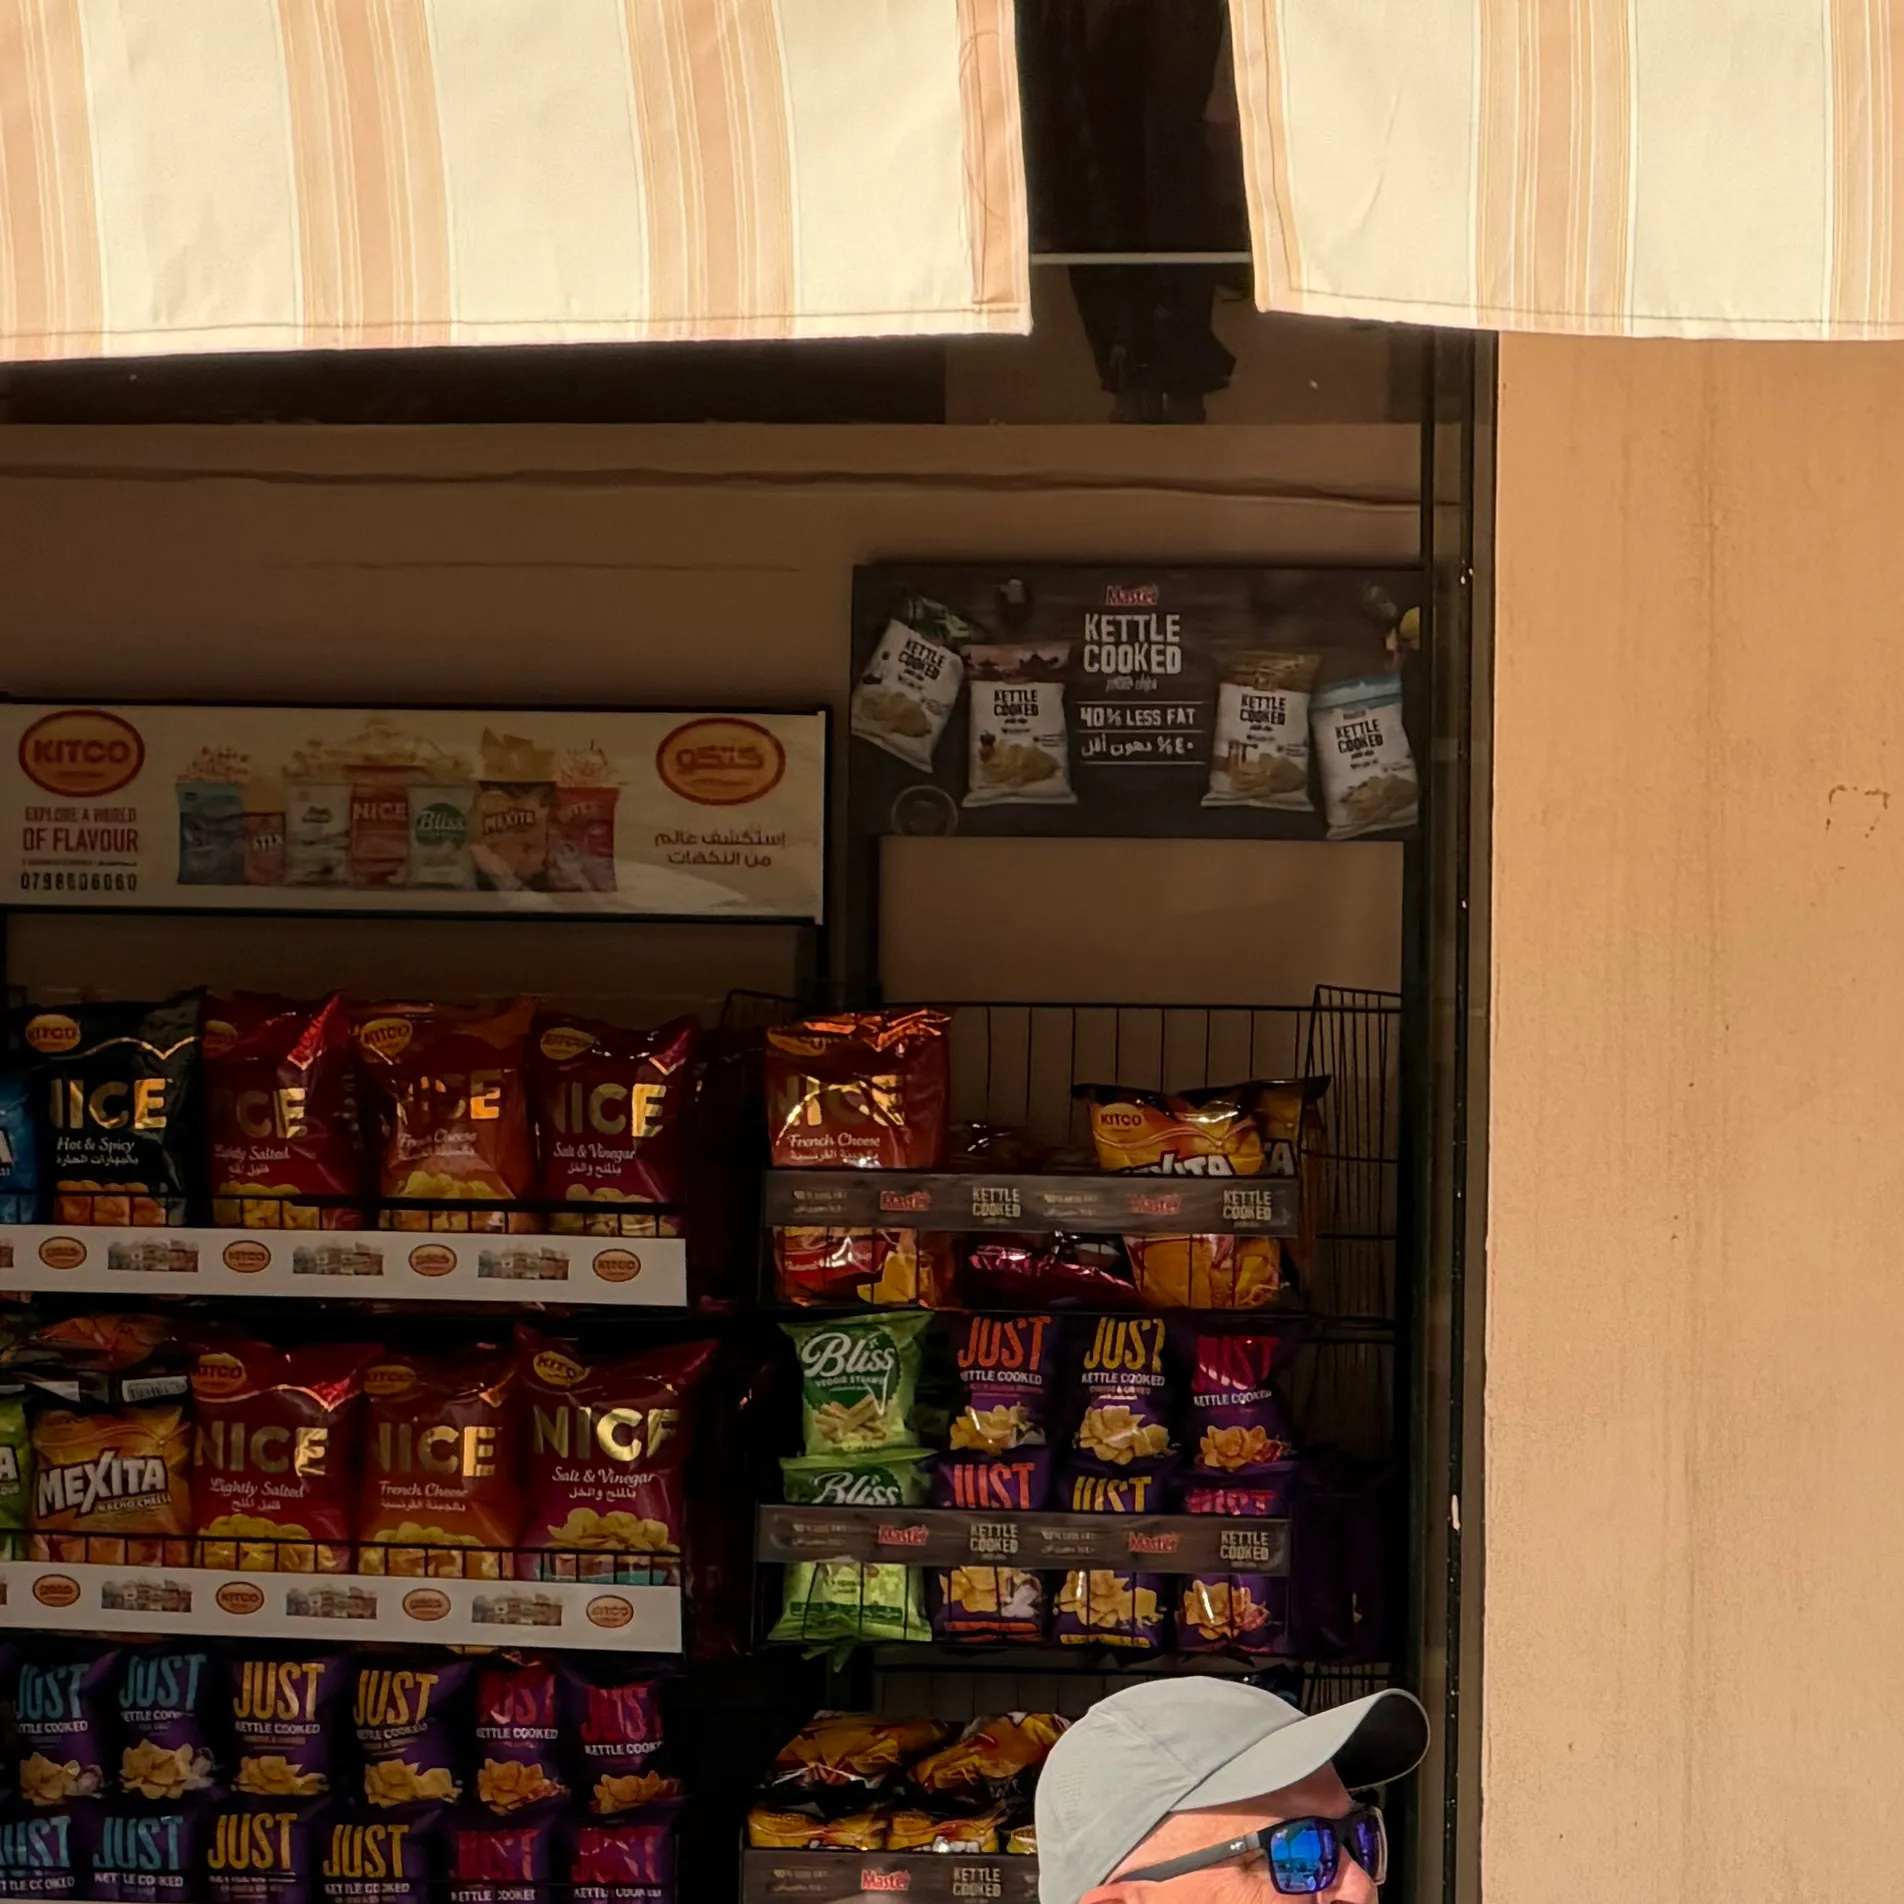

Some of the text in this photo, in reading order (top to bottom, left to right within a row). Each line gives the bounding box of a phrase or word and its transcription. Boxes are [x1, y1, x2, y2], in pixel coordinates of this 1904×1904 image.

[1085, 612, 1180, 643] KETTLE
[905, 639, 946, 668] KETTLE
[1083, 643, 1182, 674] COOKED
[898, 651, 941, 681] COOKED
[994, 690, 1038, 703] KETTLE
[1241, 694, 1286, 710] KETTLE
[994, 703, 1038, 717] COOKED
[1080, 706, 1196, 728] 40% LESS FAT
[1239, 709, 1285, 725] COOKED
[1335, 719, 1379, 739] KETTLE
[1337, 732, 1384, 753] COOKED
[33, 739, 131, 765] KITCO
[25, 807, 137, 823] EXPLORE A WORLD
[352, 802, 408, 820] NICE
[416, 808, 466, 833] Bliss
[22, 827, 138, 852] OF FLAVOUR
[744, 853, 771, 867] من
[1101, 1112, 1142, 1127] KITCO
[57, 1136, 136, 1156] Hot & Spicy
[837, 1132, 880, 1148] Cheese
[552, 1142, 574, 1158] Salt
[591, 1142, 636, 1163] Vinegar
[972, 1188, 1020, 1203] KETTLE
[1223, 1190, 1271, 1203] KETTLE
[972, 1203, 1021, 1218] COOKED
[1222, 1204, 1272, 1221] COOKED
[957, 1316, 1052, 1372] JUST
[801, 1331, 896, 1379] Bliss
[997, 1371, 1042, 1385] COOKED
[1081, 1372, 1166, 1388] KETTLE COOKED
[37, 1450, 169, 1518] MEXITA
[551, 1464, 656, 1488] Salt & Vinegar
[209, 1476, 307, 1499] Lightly Salted
[379, 1479, 469, 1499] French Cheese
[969, 1523, 1019, 1538] KETTLE
[1220, 1531, 1269, 1546] KETTLE
[969, 1538, 1020, 1553] COOKED
[1219, 1545, 1270, 1561] COOKED
[118, 1653, 208, 1711] JUST
[232, 1661, 326, 1722] JUST
[352, 1669, 439, 1727] JUST
[45, 1720, 89, 1734] COOKED
[235, 1720, 321, 1735] KETTLE COOKED
[383, 1723, 428, 1739] COOKED
[513, 1727, 559, 1740] COOKED
[584, 1743, 625, 1757] KETTLE
[92, 1815, 184, 1871] JUST
[207, 1812, 299, 1871] JUST
[322, 1823, 409, 1879] JUST
[860, 1868, 912, 1891] Master
[953, 1867, 1000, 1883] KETTLE
[953, 1882, 1001, 1898] COOKED
